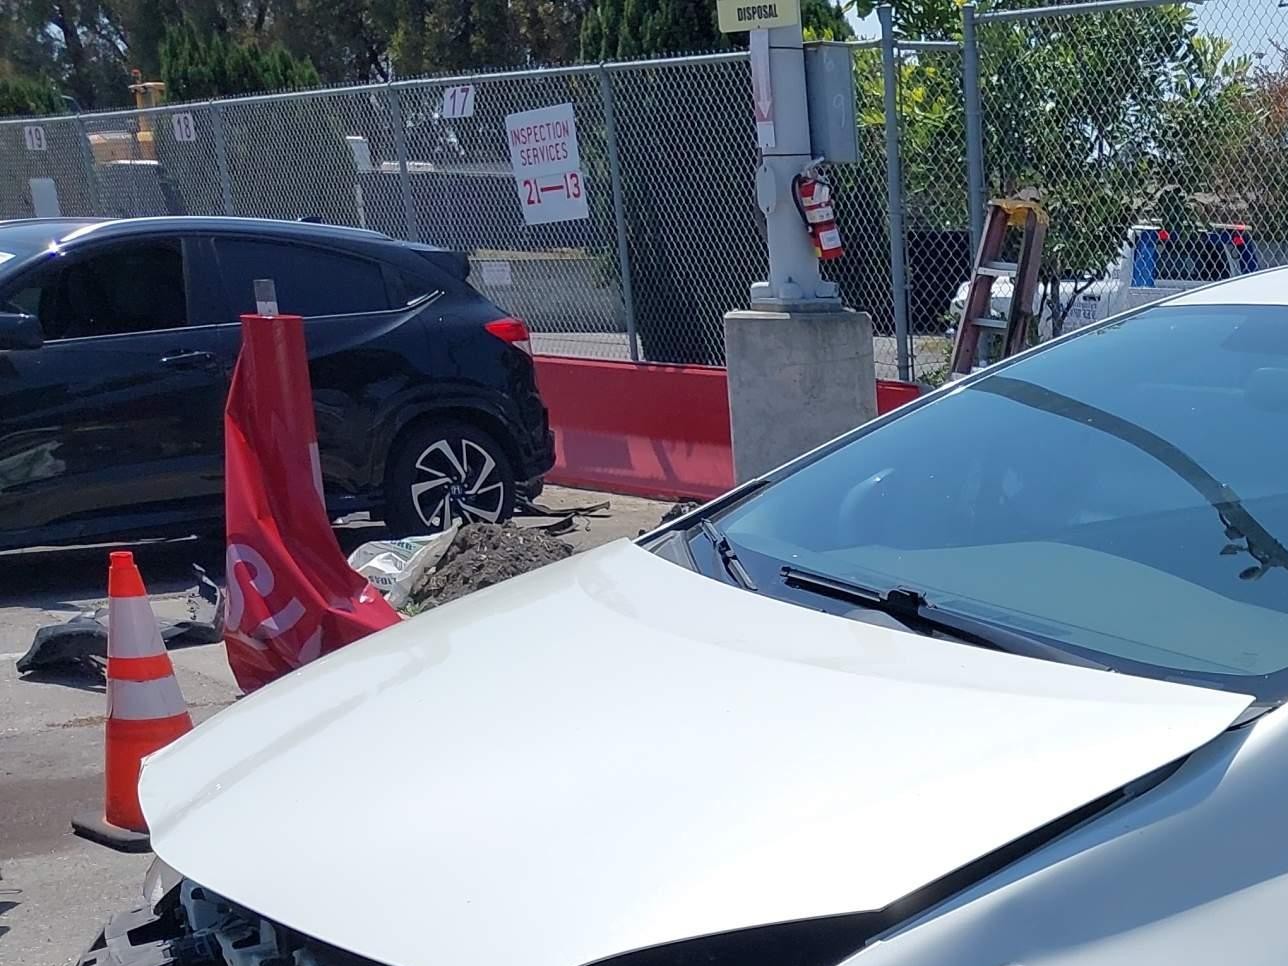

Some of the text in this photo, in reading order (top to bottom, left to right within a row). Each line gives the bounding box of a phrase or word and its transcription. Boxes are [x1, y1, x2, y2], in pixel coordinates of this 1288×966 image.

[737, 3, 778, 22] DISPOSAL
[450, 87, 470, 116] 17
[27, 128, 43, 150] 19
[176, 114, 192, 140] 18
[511, 120, 570, 146] INSPECTION
[520, 142, 568, 166] SERVICES
